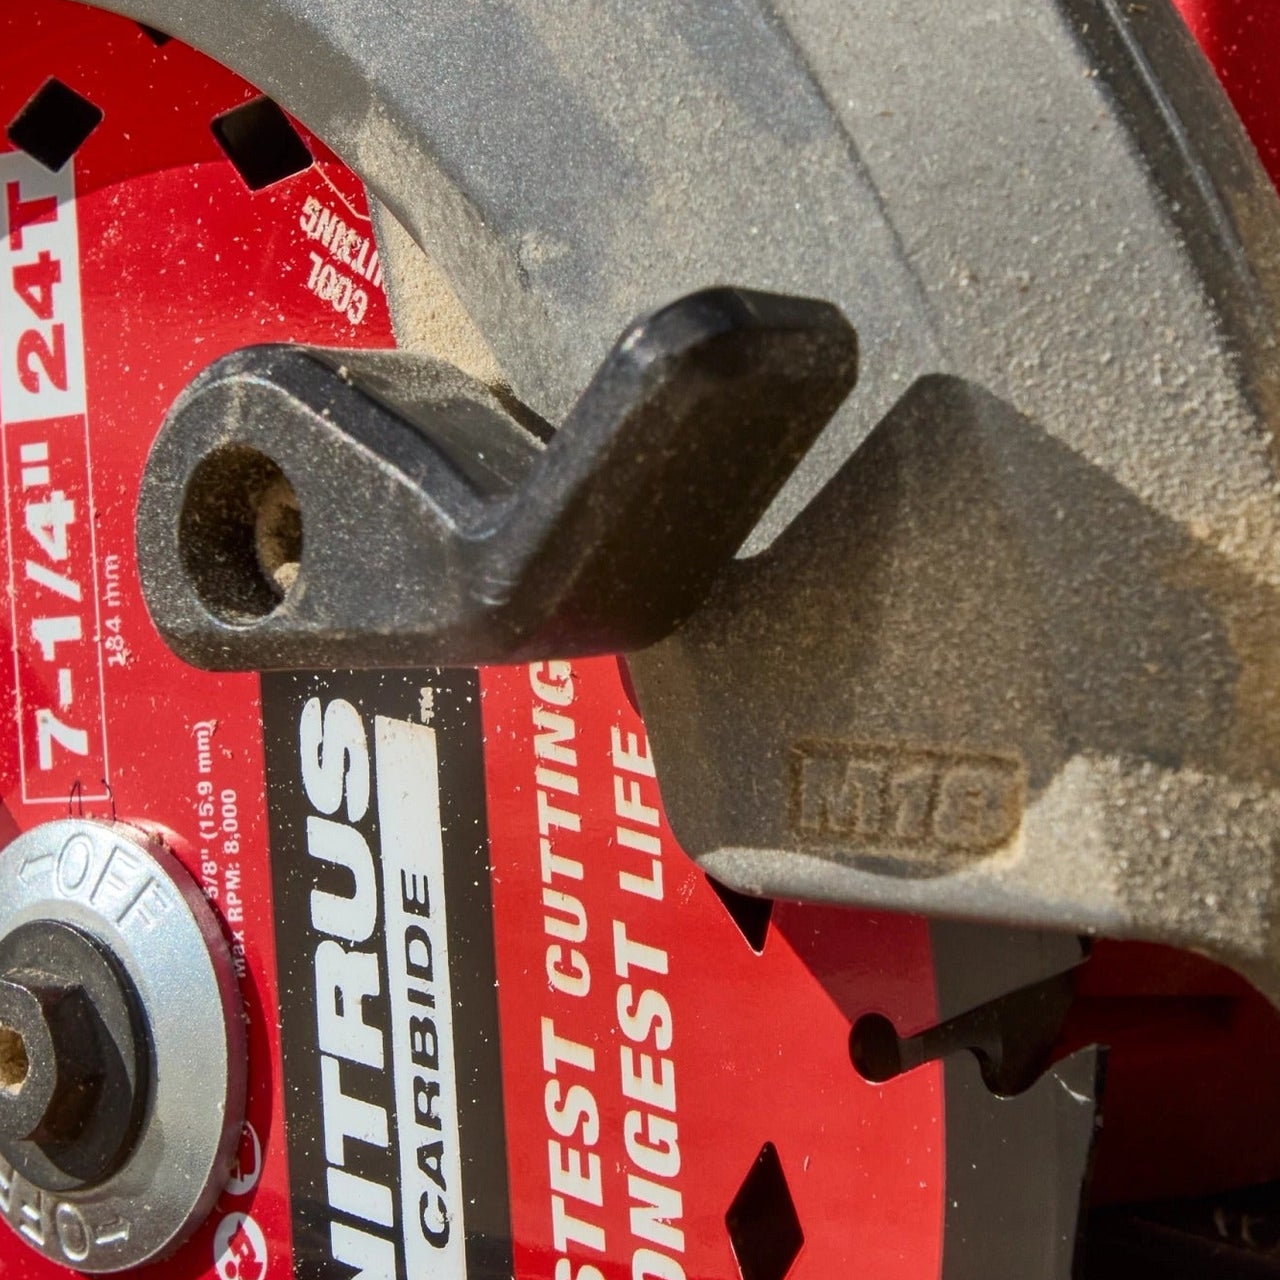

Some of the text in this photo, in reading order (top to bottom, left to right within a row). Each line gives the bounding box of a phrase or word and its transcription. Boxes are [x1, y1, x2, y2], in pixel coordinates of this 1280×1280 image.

[299, 195, 387, 296] UTTING
[307, 251, 368, 324] COOL
[6, 180, 88, 771] 7-1/4" 24T
[104, 554, 127, 667] 184 mm
[193, 720, 215, 774] mm)
[220, 788, 242, 855] 8,000
[528, 659, 592, 997] CUTTING
[610, 725, 665, 902] LIFE
[56, 831, 172, 928] OFF
[224, 862, 244, 923] RPM:
[403, 871, 451, 1250] CARBIDE
